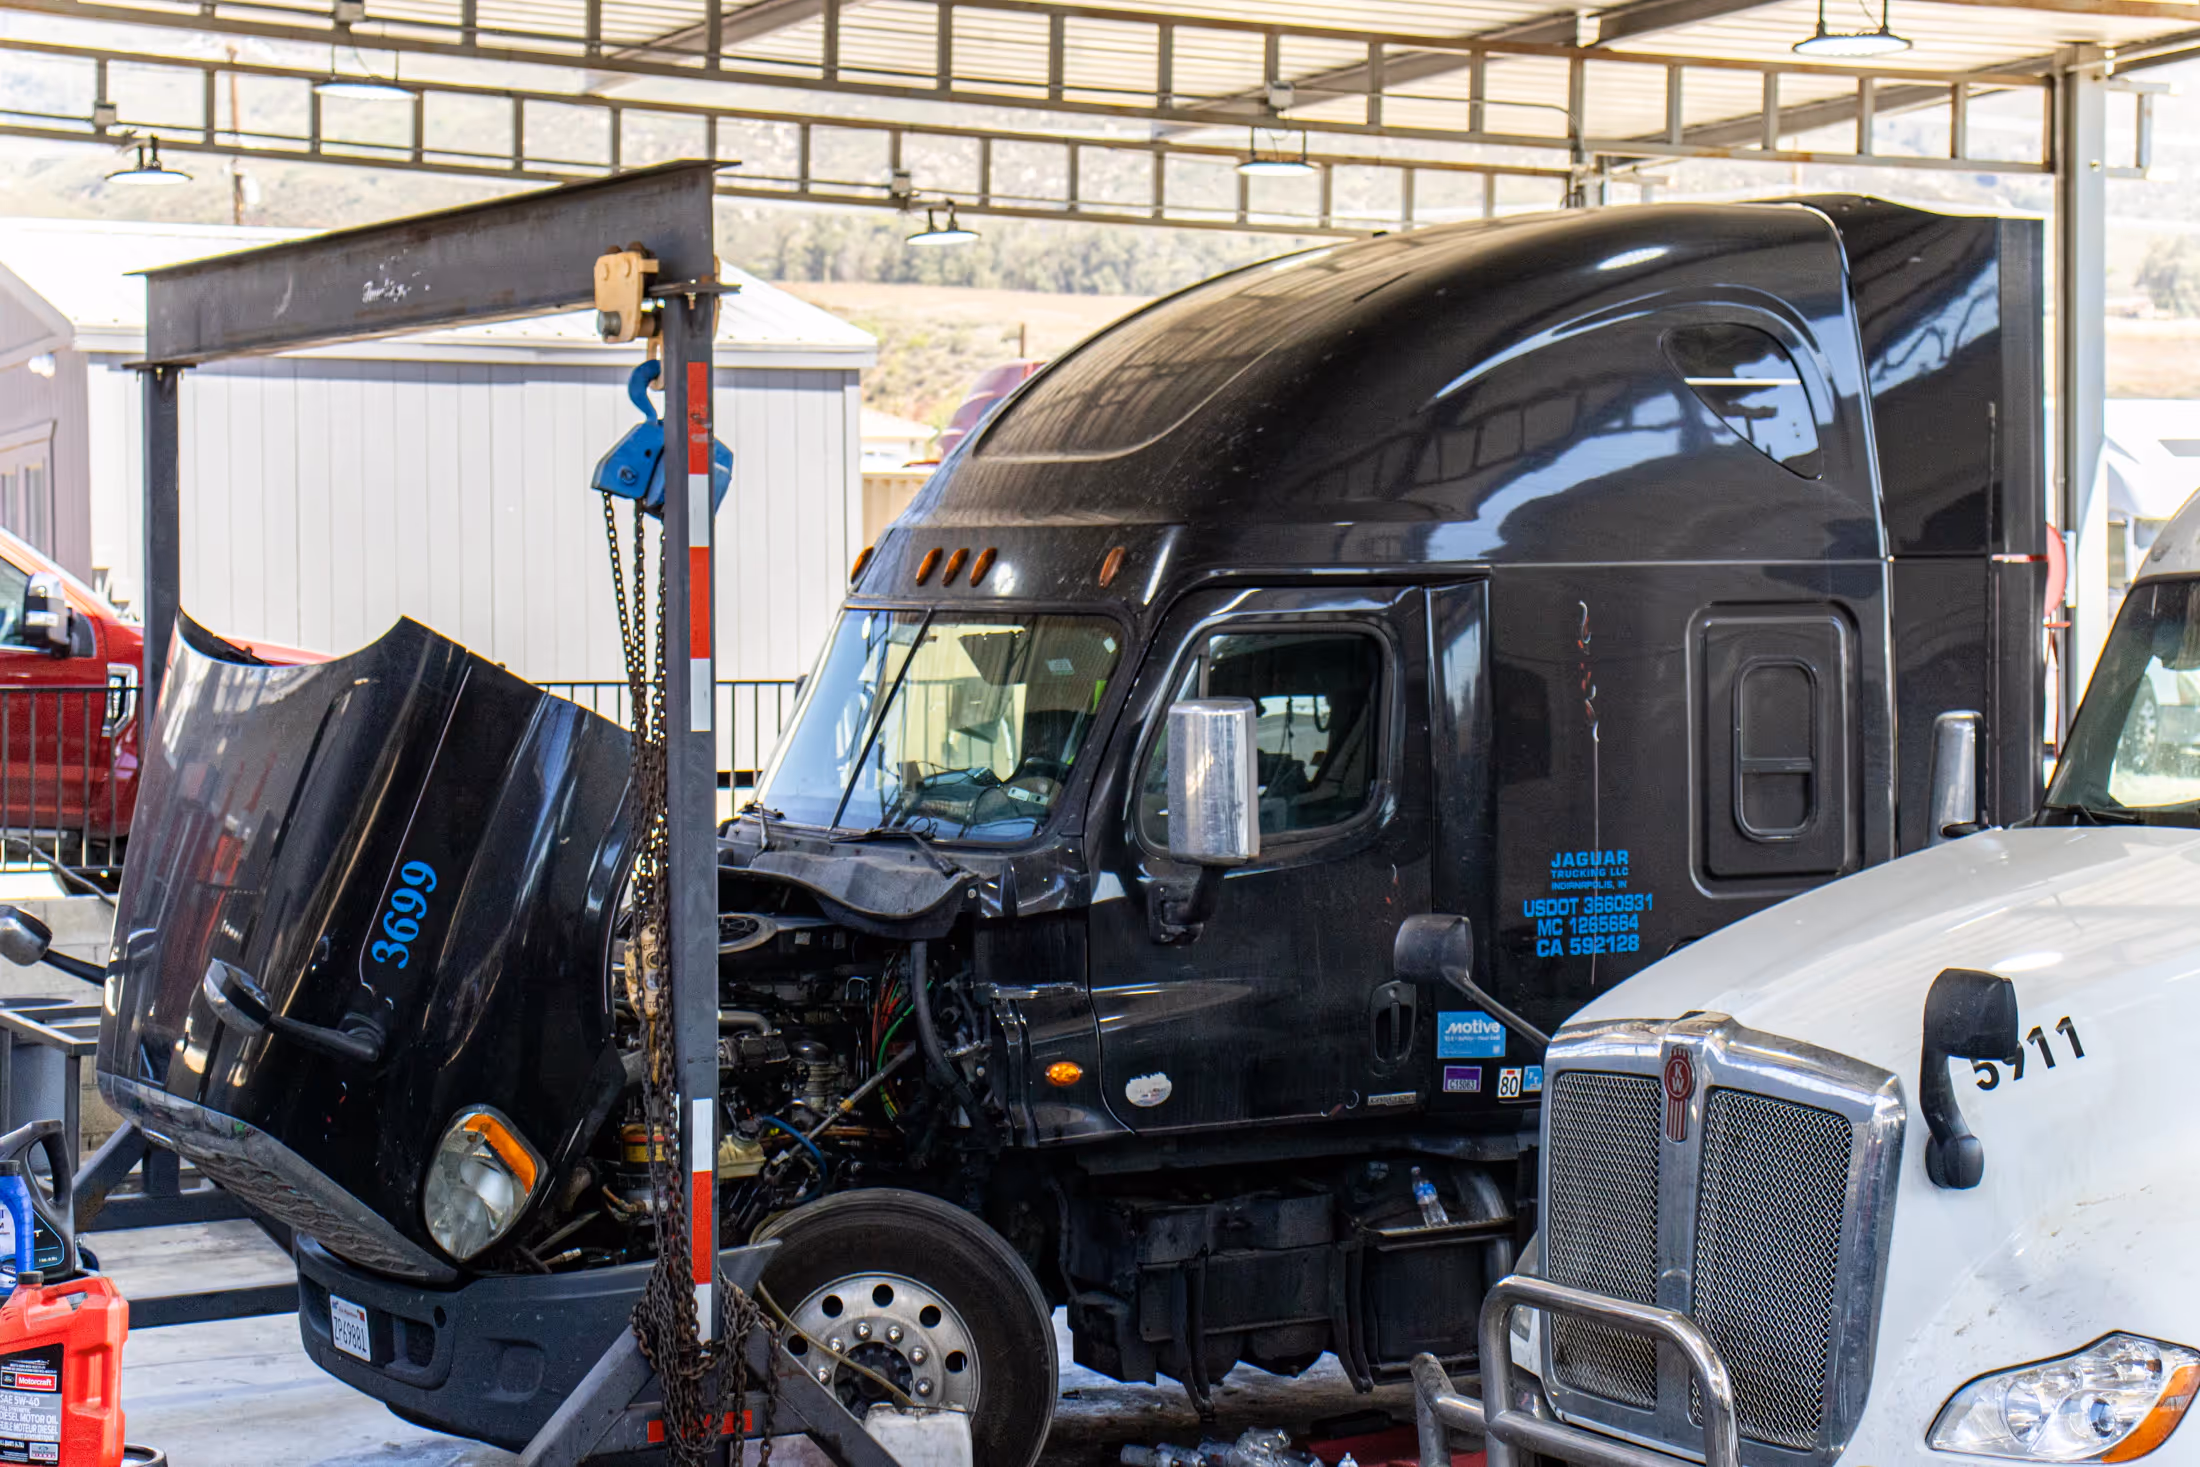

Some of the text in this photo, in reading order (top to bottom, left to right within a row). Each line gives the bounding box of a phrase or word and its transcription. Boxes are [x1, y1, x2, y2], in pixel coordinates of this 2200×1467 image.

[1551, 849, 1629, 868] JAGUAR
[1551, 867, 1629, 879] TRUCKING LLC
[1617, 880, 1627, 888] IN
[1523, 893, 1653, 917] USDOT 3660931
[371, 860, 438, 969] 3699
[1537, 913, 1639, 937] MC 1265664
[1536, 933, 1640, 958] CA 592128
[1445, 1019, 1500, 1034] Motive
[1500, 1076, 1519, 1096] 80
[18, 1376, 52, 1387] Motorcraft
[0, 1394, 40, 1407] SAE 5W-40
[0, 1411, 58, 1425] DIESEL MOTOR OIL
[38, 1424, 58, 1435] DIESEL
